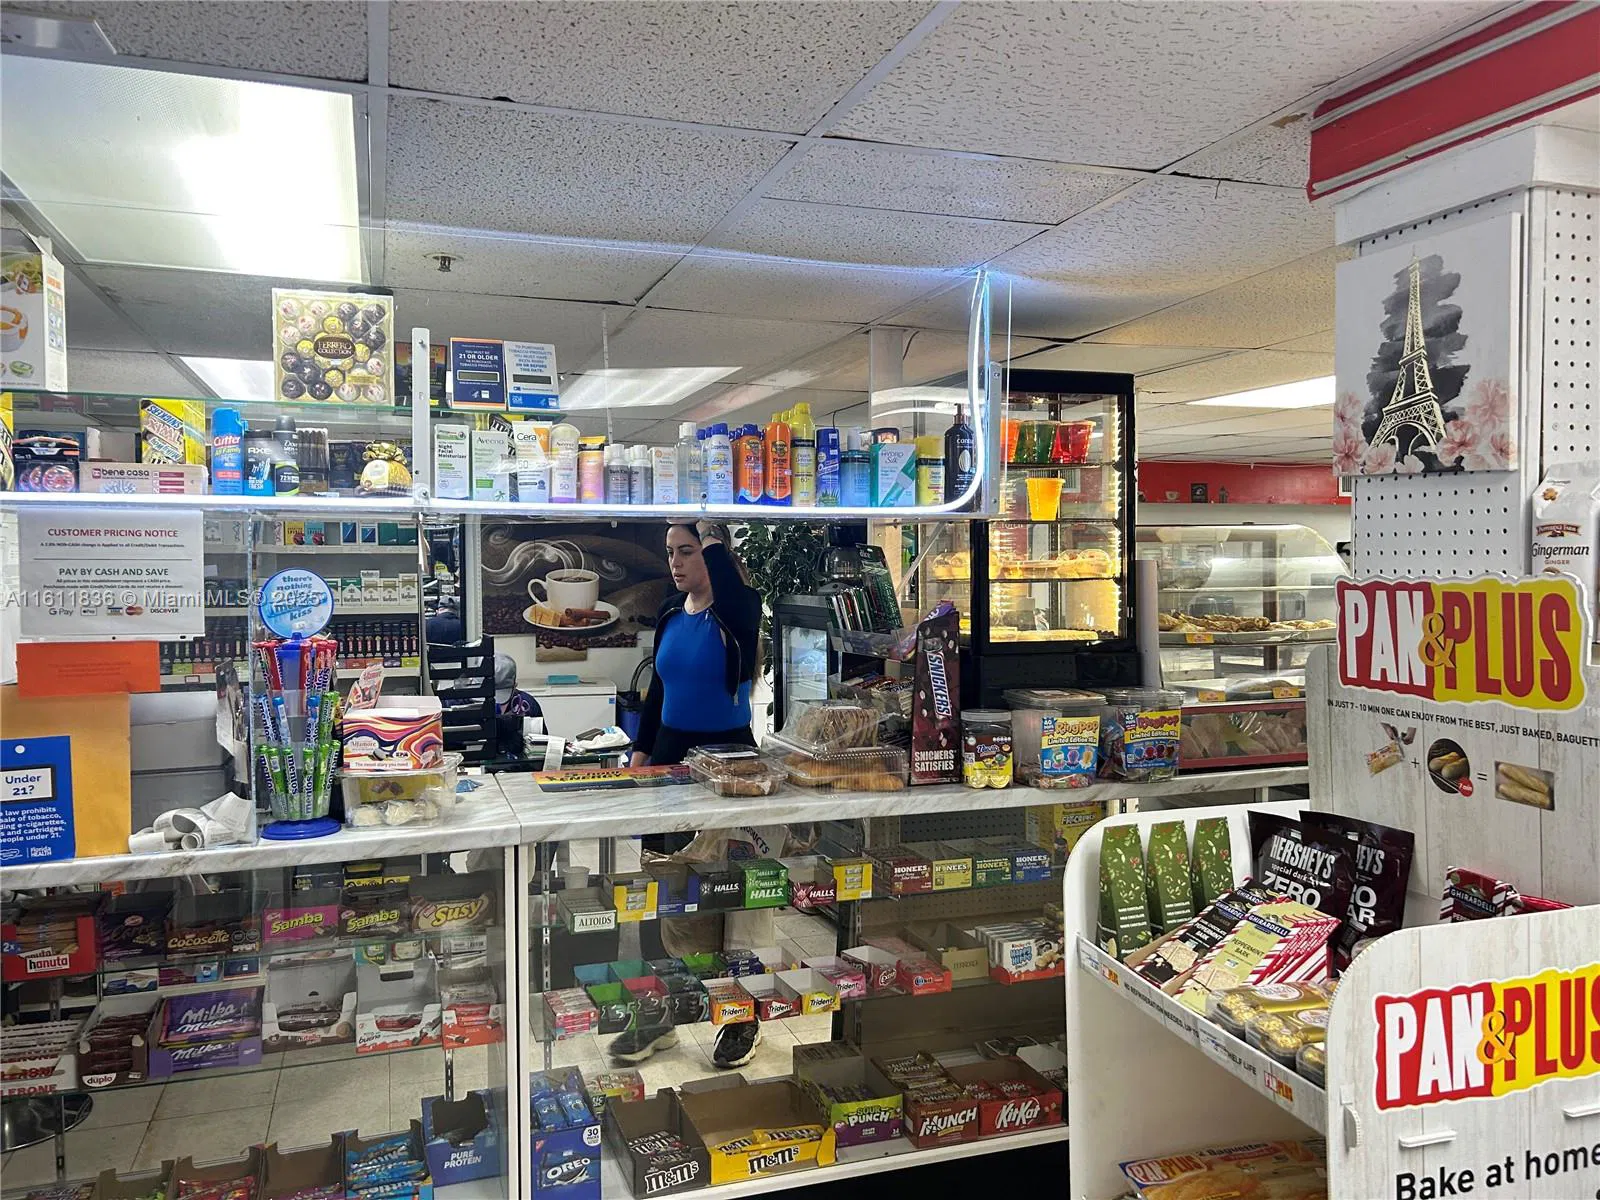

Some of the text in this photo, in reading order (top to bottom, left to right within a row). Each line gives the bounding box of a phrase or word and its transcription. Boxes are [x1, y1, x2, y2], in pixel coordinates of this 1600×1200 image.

[214, 436, 240, 446] Cutter
[48, 528, 101, 537] CUSTOMER
[104, 529, 142, 537] PRICING
[1532, 543, 1589, 559] Gingerman
[59, 608, 74, 616] Pay
[290, 608, 312, 620] kiss
[1343, 590, 1426, 687] PAN
[1442, 591, 1572, 702] PLUS
[928, 654, 950, 716] SNICKERS
[1335, 700, 1349, 709] JUST
[1368, 705, 1379, 714] MIN
[1381, 706, 1395, 716] ONE
[1396, 708, 1410, 718] CAN
[1412, 710, 1434, 722] ENJOY
[1436, 714, 1456, 725] FROM
[1459, 718, 1473, 728] THE
[1475, 720, 1497, 733] BEST,
[1499, 723, 1520, 736] JUST
[1522, 727, 1555, 742] BAKED,
[1131, 731, 1150, 739] Limited
[915, 750, 954, 760] SNICKERS
[915, 761, 954, 771] SATISFIES
[5, 774, 42, 784] Under
[288, 755, 299, 794] mentos
[13, 786, 34, 796] 21?
[21, 807, 56, 815] prohibits
[1270, 834, 1335, 879] HERSHEY'S
[894, 865, 928, 873] HONEES
[976, 861, 1009, 870] HONEES
[1271, 864, 1308, 881] special dark
[1450, 889, 1496, 913] GHIRARDELLI
[432, 900, 481, 927] Susy
[271, 913, 324, 934] Samba
[347, 909, 399, 932] Samba
[579, 916, 612, 927] ALTOIDS
[1249, 914, 1290, 936] GHIRARDELLI
[1194, 922, 1223, 940] PEPPERMINT
[168, 930, 230, 948] Cocosette
[3, 942, 15, 952] 2x
[1232, 937, 1265, 958] PEPPERMINT
[1235, 947, 1249, 958] BARK
[29, 957, 68, 970] hanuta
[768, 1003, 792, 1012] Trident
[810, 998, 834, 1007] Trident
[180, 1001, 237, 1024] Milka
[720, 1007, 747, 1017] Trident
[358, 1034, 381, 1044] bueno
[171, 1043, 224, 1060] Milka
[1384, 991, 1484, 1101] PAN
[87, 1076, 113, 1085] duplo
[857, 1107, 881, 1116] SOUR
[848, 1111, 889, 1127] PUNCH
[920, 1107, 977, 1136] MUNCH
[451, 1150, 474, 1160] PURE
[444, 1156, 482, 1169] PROTEIN
[547, 1158, 590, 1179] OREO
[1396, 1142, 1600, 1200] Bake at home
